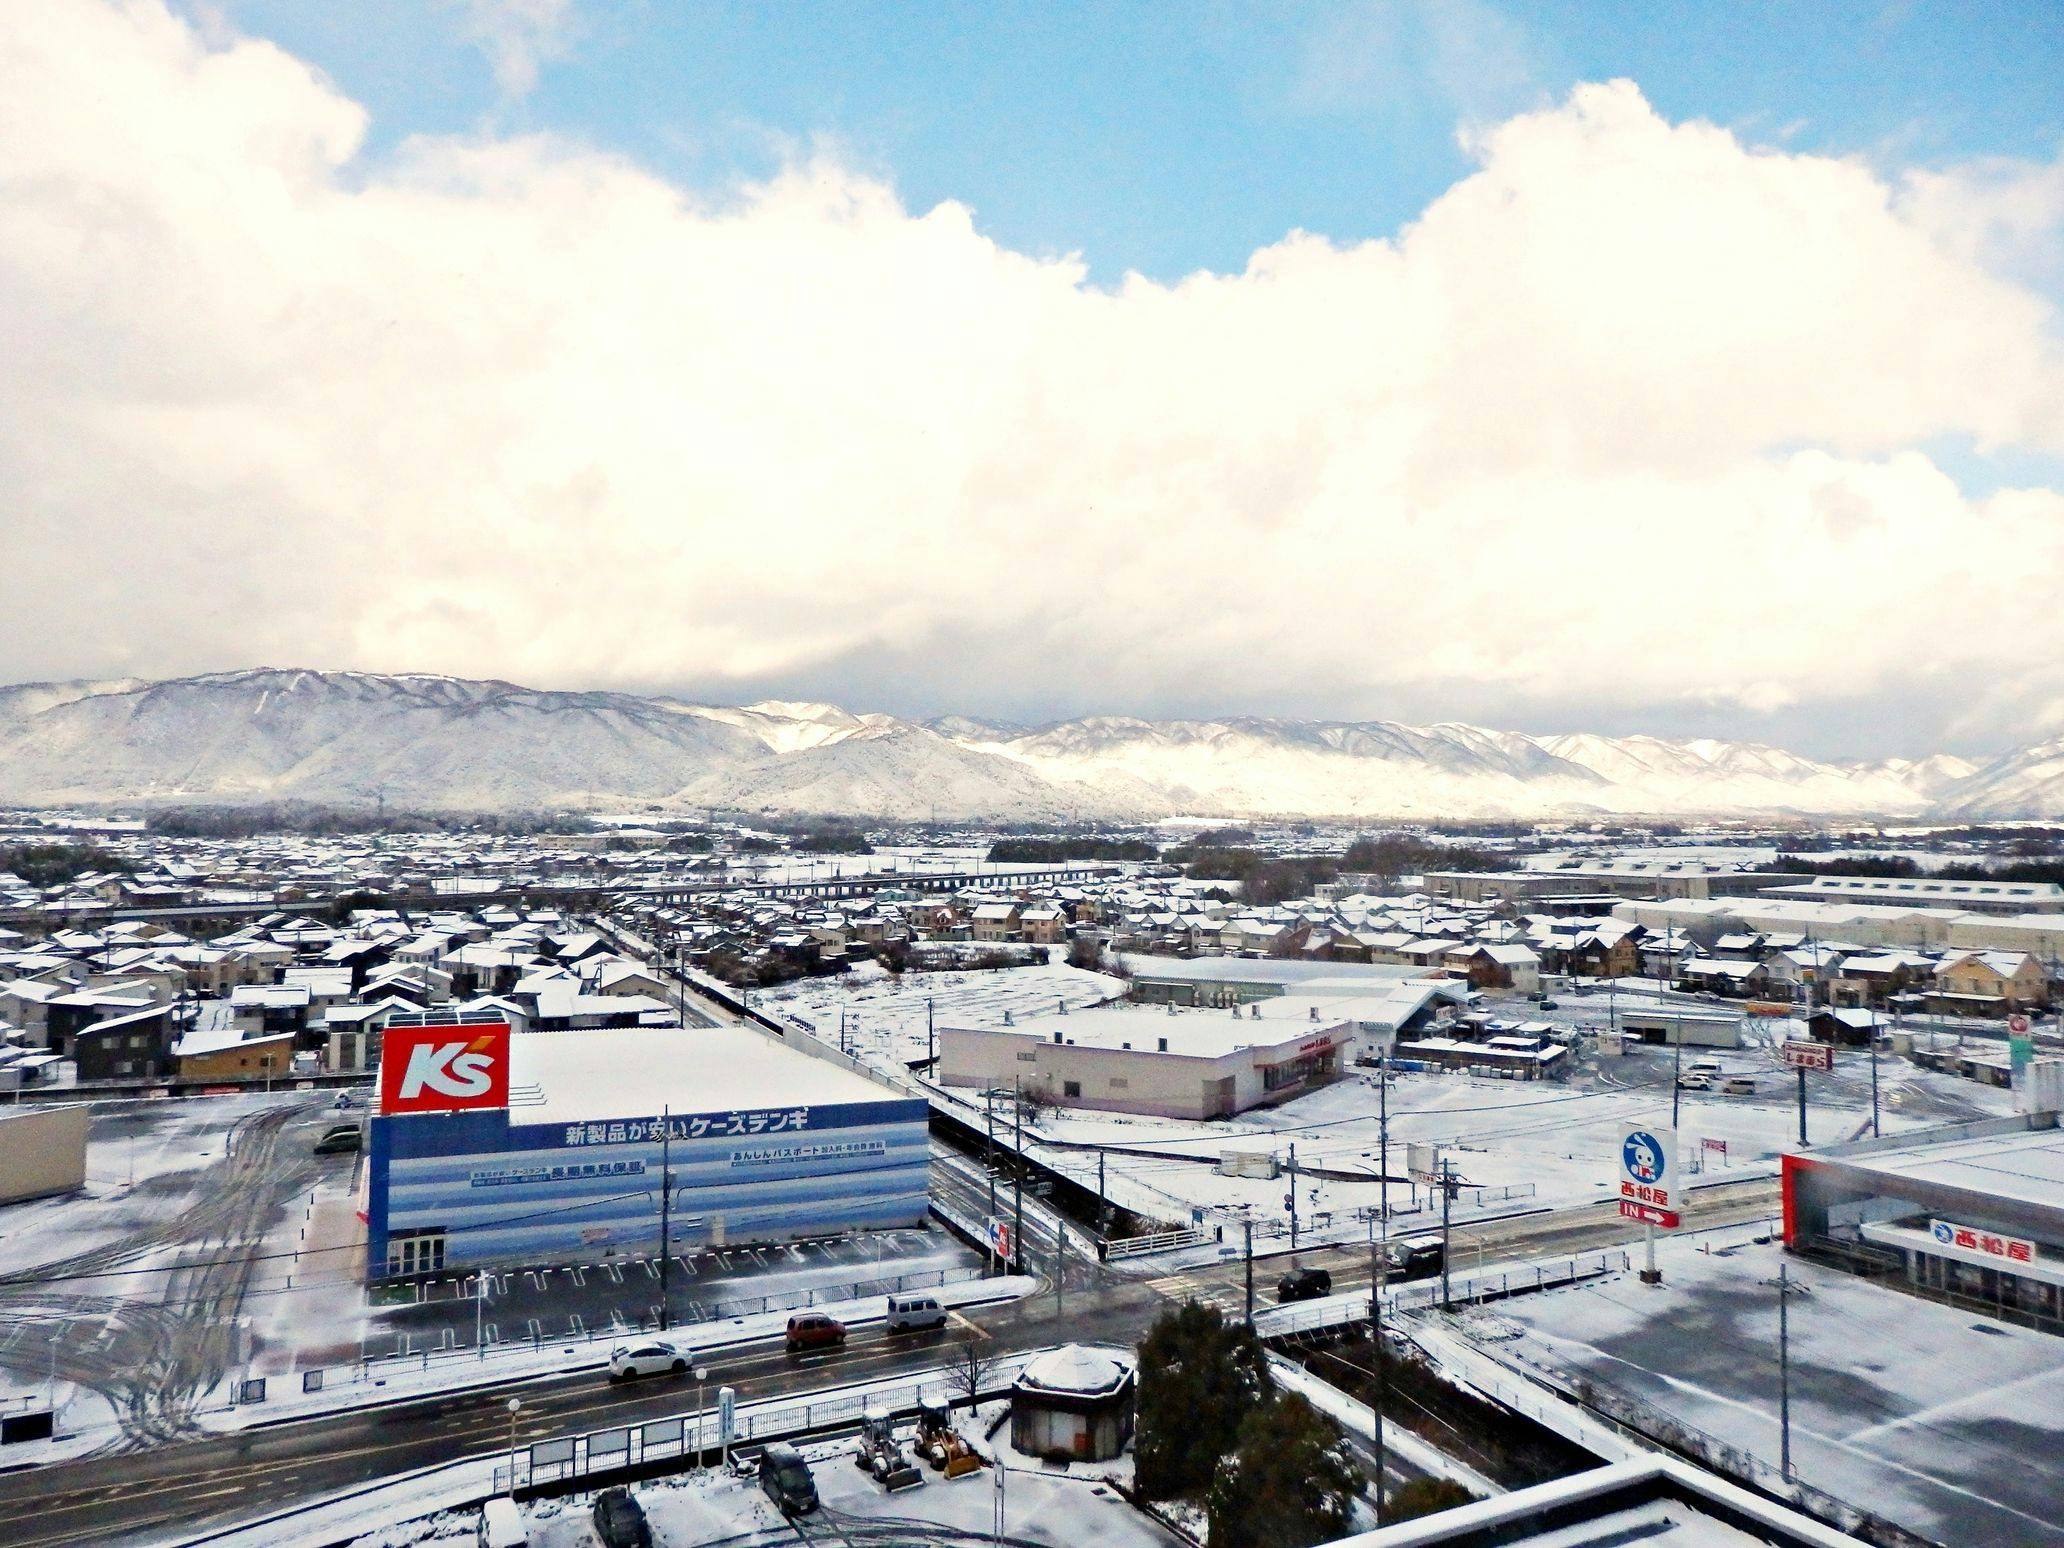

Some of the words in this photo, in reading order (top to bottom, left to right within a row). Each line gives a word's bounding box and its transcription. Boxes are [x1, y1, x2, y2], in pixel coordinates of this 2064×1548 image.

[399, 1035, 496, 1098] K's
[566, 1110, 808, 1145] 新製品が安いケーズデンキ
[1621, 1180, 1668, 1206] 西松屋
[1624, 1203, 1639, 1217] IN
[1955, 1229, 2031, 1262] 西松屋
